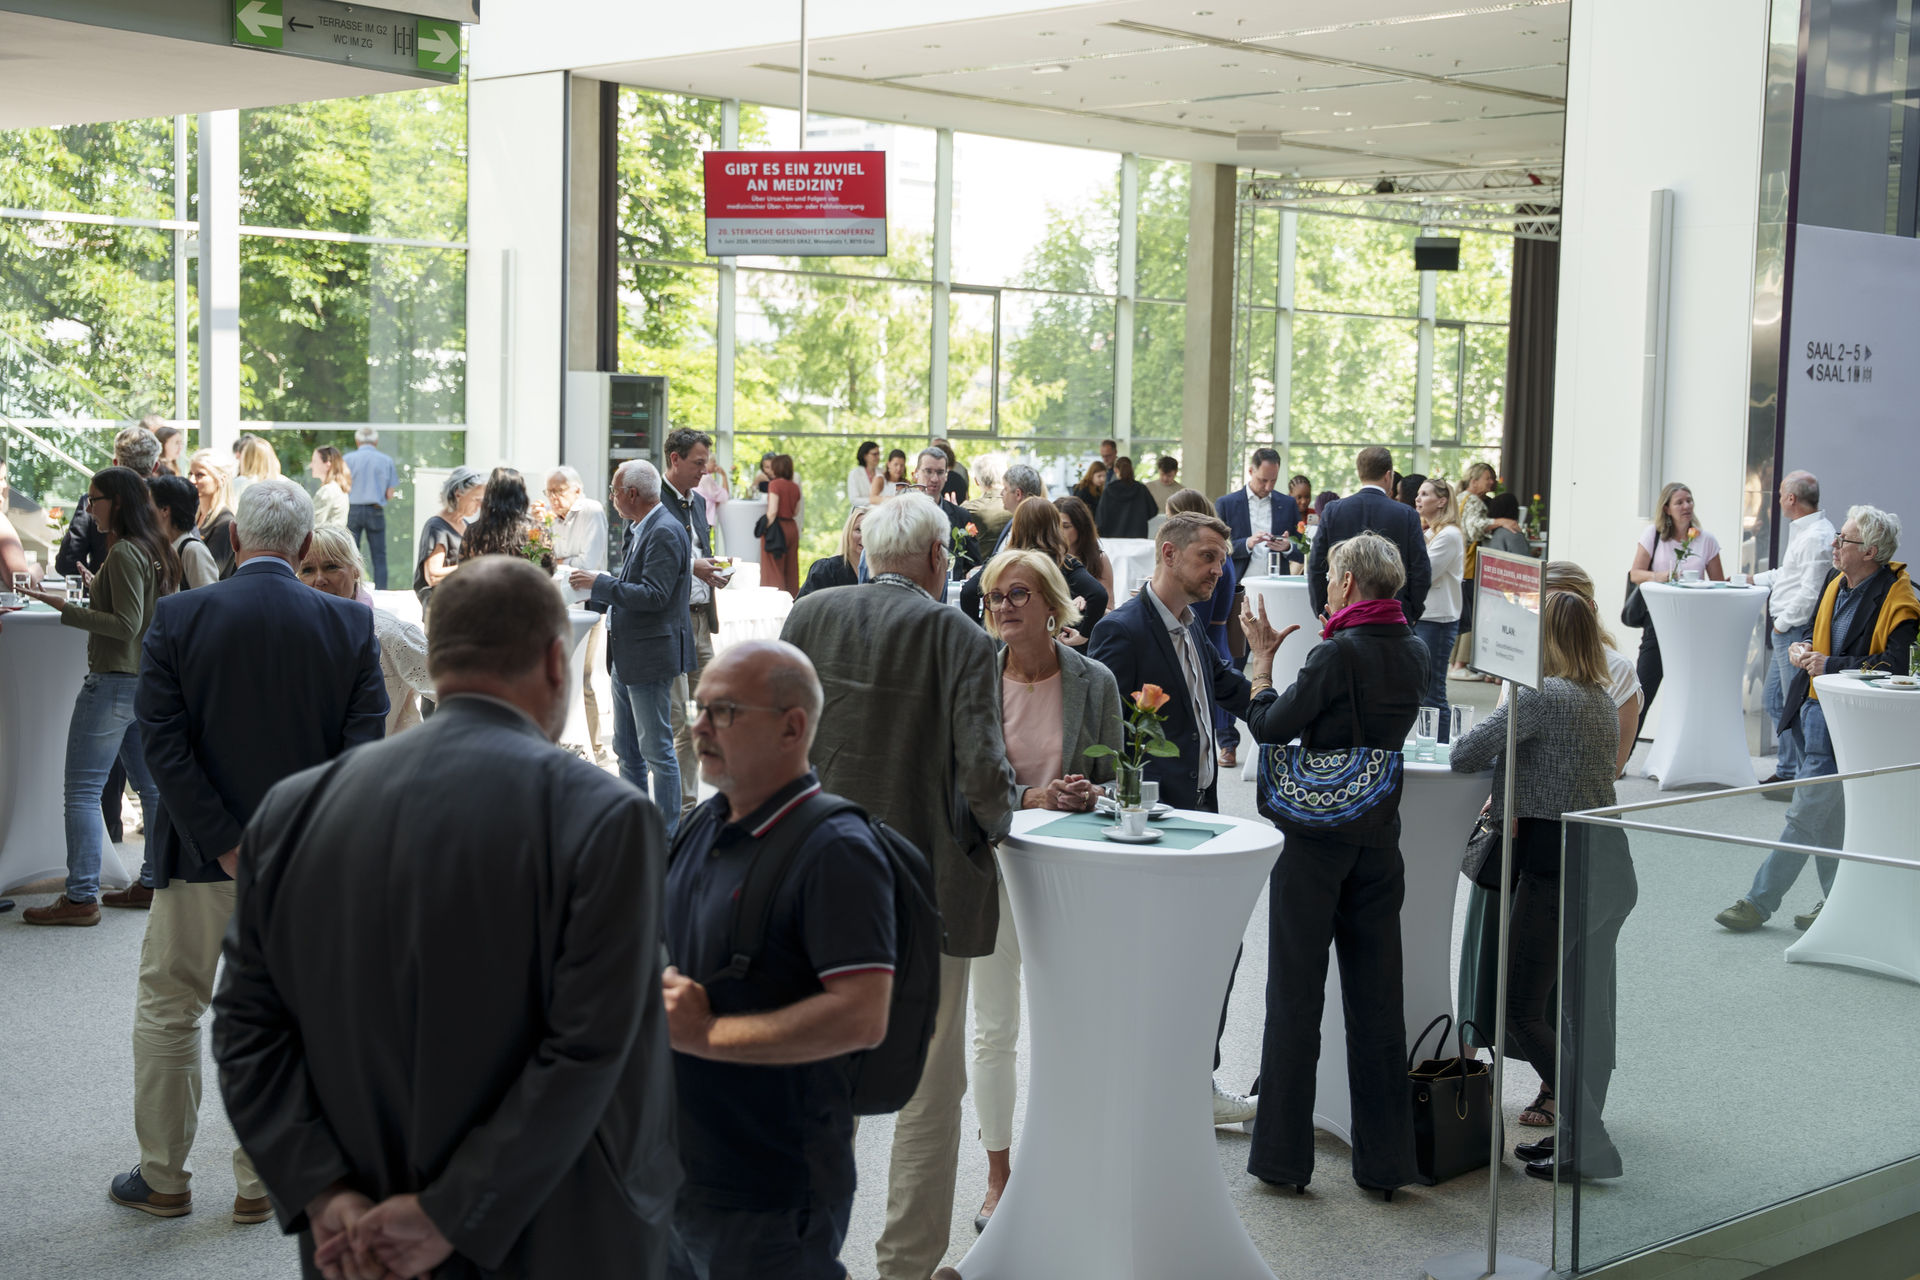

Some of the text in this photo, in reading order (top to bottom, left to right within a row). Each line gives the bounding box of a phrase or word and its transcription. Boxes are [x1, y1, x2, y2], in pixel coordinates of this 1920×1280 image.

[318, 16, 388, 35] TERRASSE IM G2
[333, 34, 373, 48] WC IM ZG
[725, 163, 865, 176] GIBT ES EIN ZUVIEL
[746, 179, 844, 192] AN MEDIZIN?
[808, 195, 827, 204] Folgen
[731, 228, 774, 236] STEIRISCHE
[776, 228, 875, 236] GESUNDHEITSKONFERENZ
[1807, 341, 1835, 360] SAAL
[1816, 363, 1845, 382] SAAL
